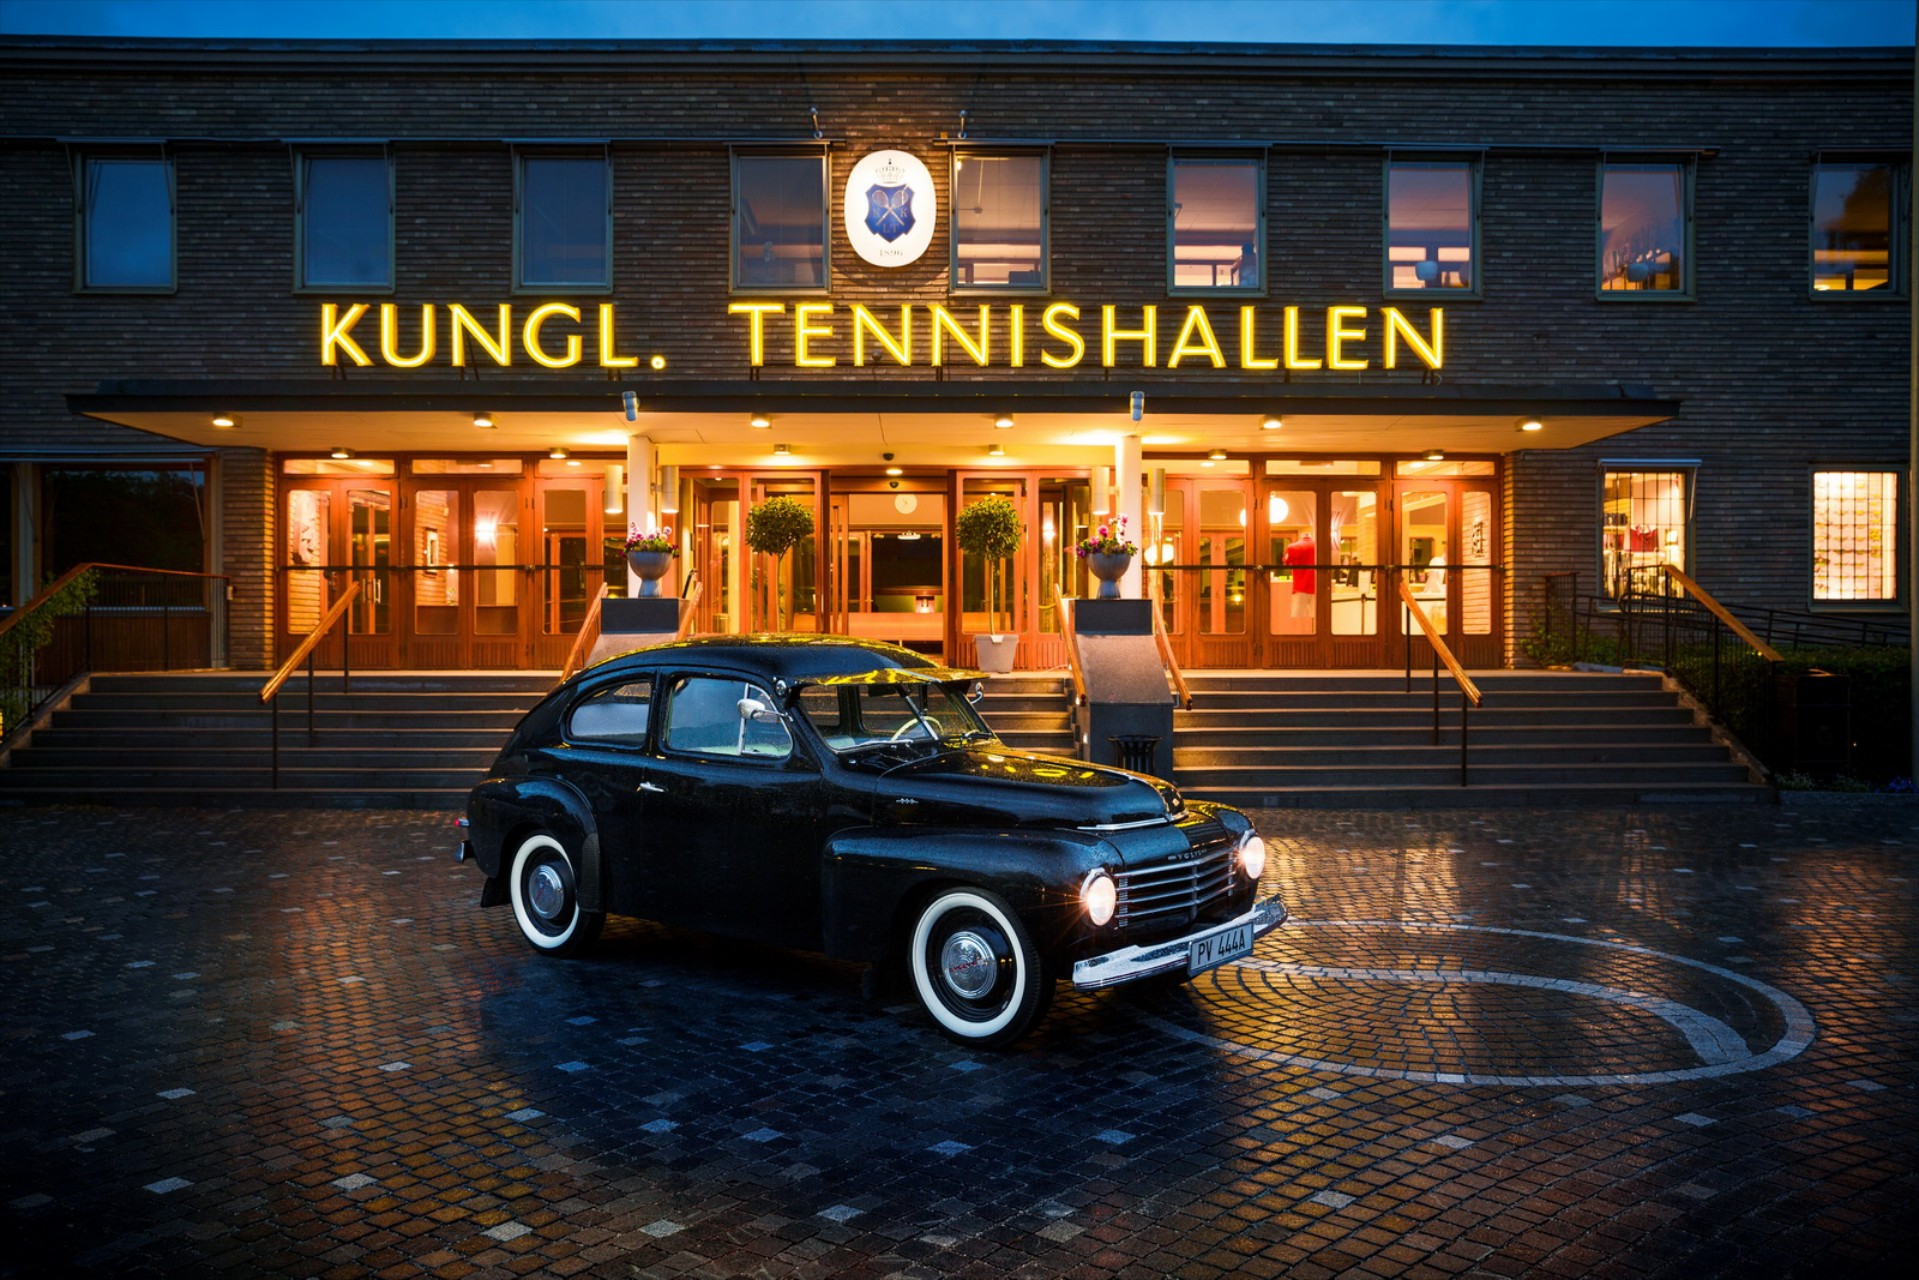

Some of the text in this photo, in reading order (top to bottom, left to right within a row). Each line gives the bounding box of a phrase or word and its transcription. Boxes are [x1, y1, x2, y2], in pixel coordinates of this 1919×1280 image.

[320, 302, 1444, 370] KUNGL. TENNISHALLEN
[1197, 928, 1246, 965] PV 444A
